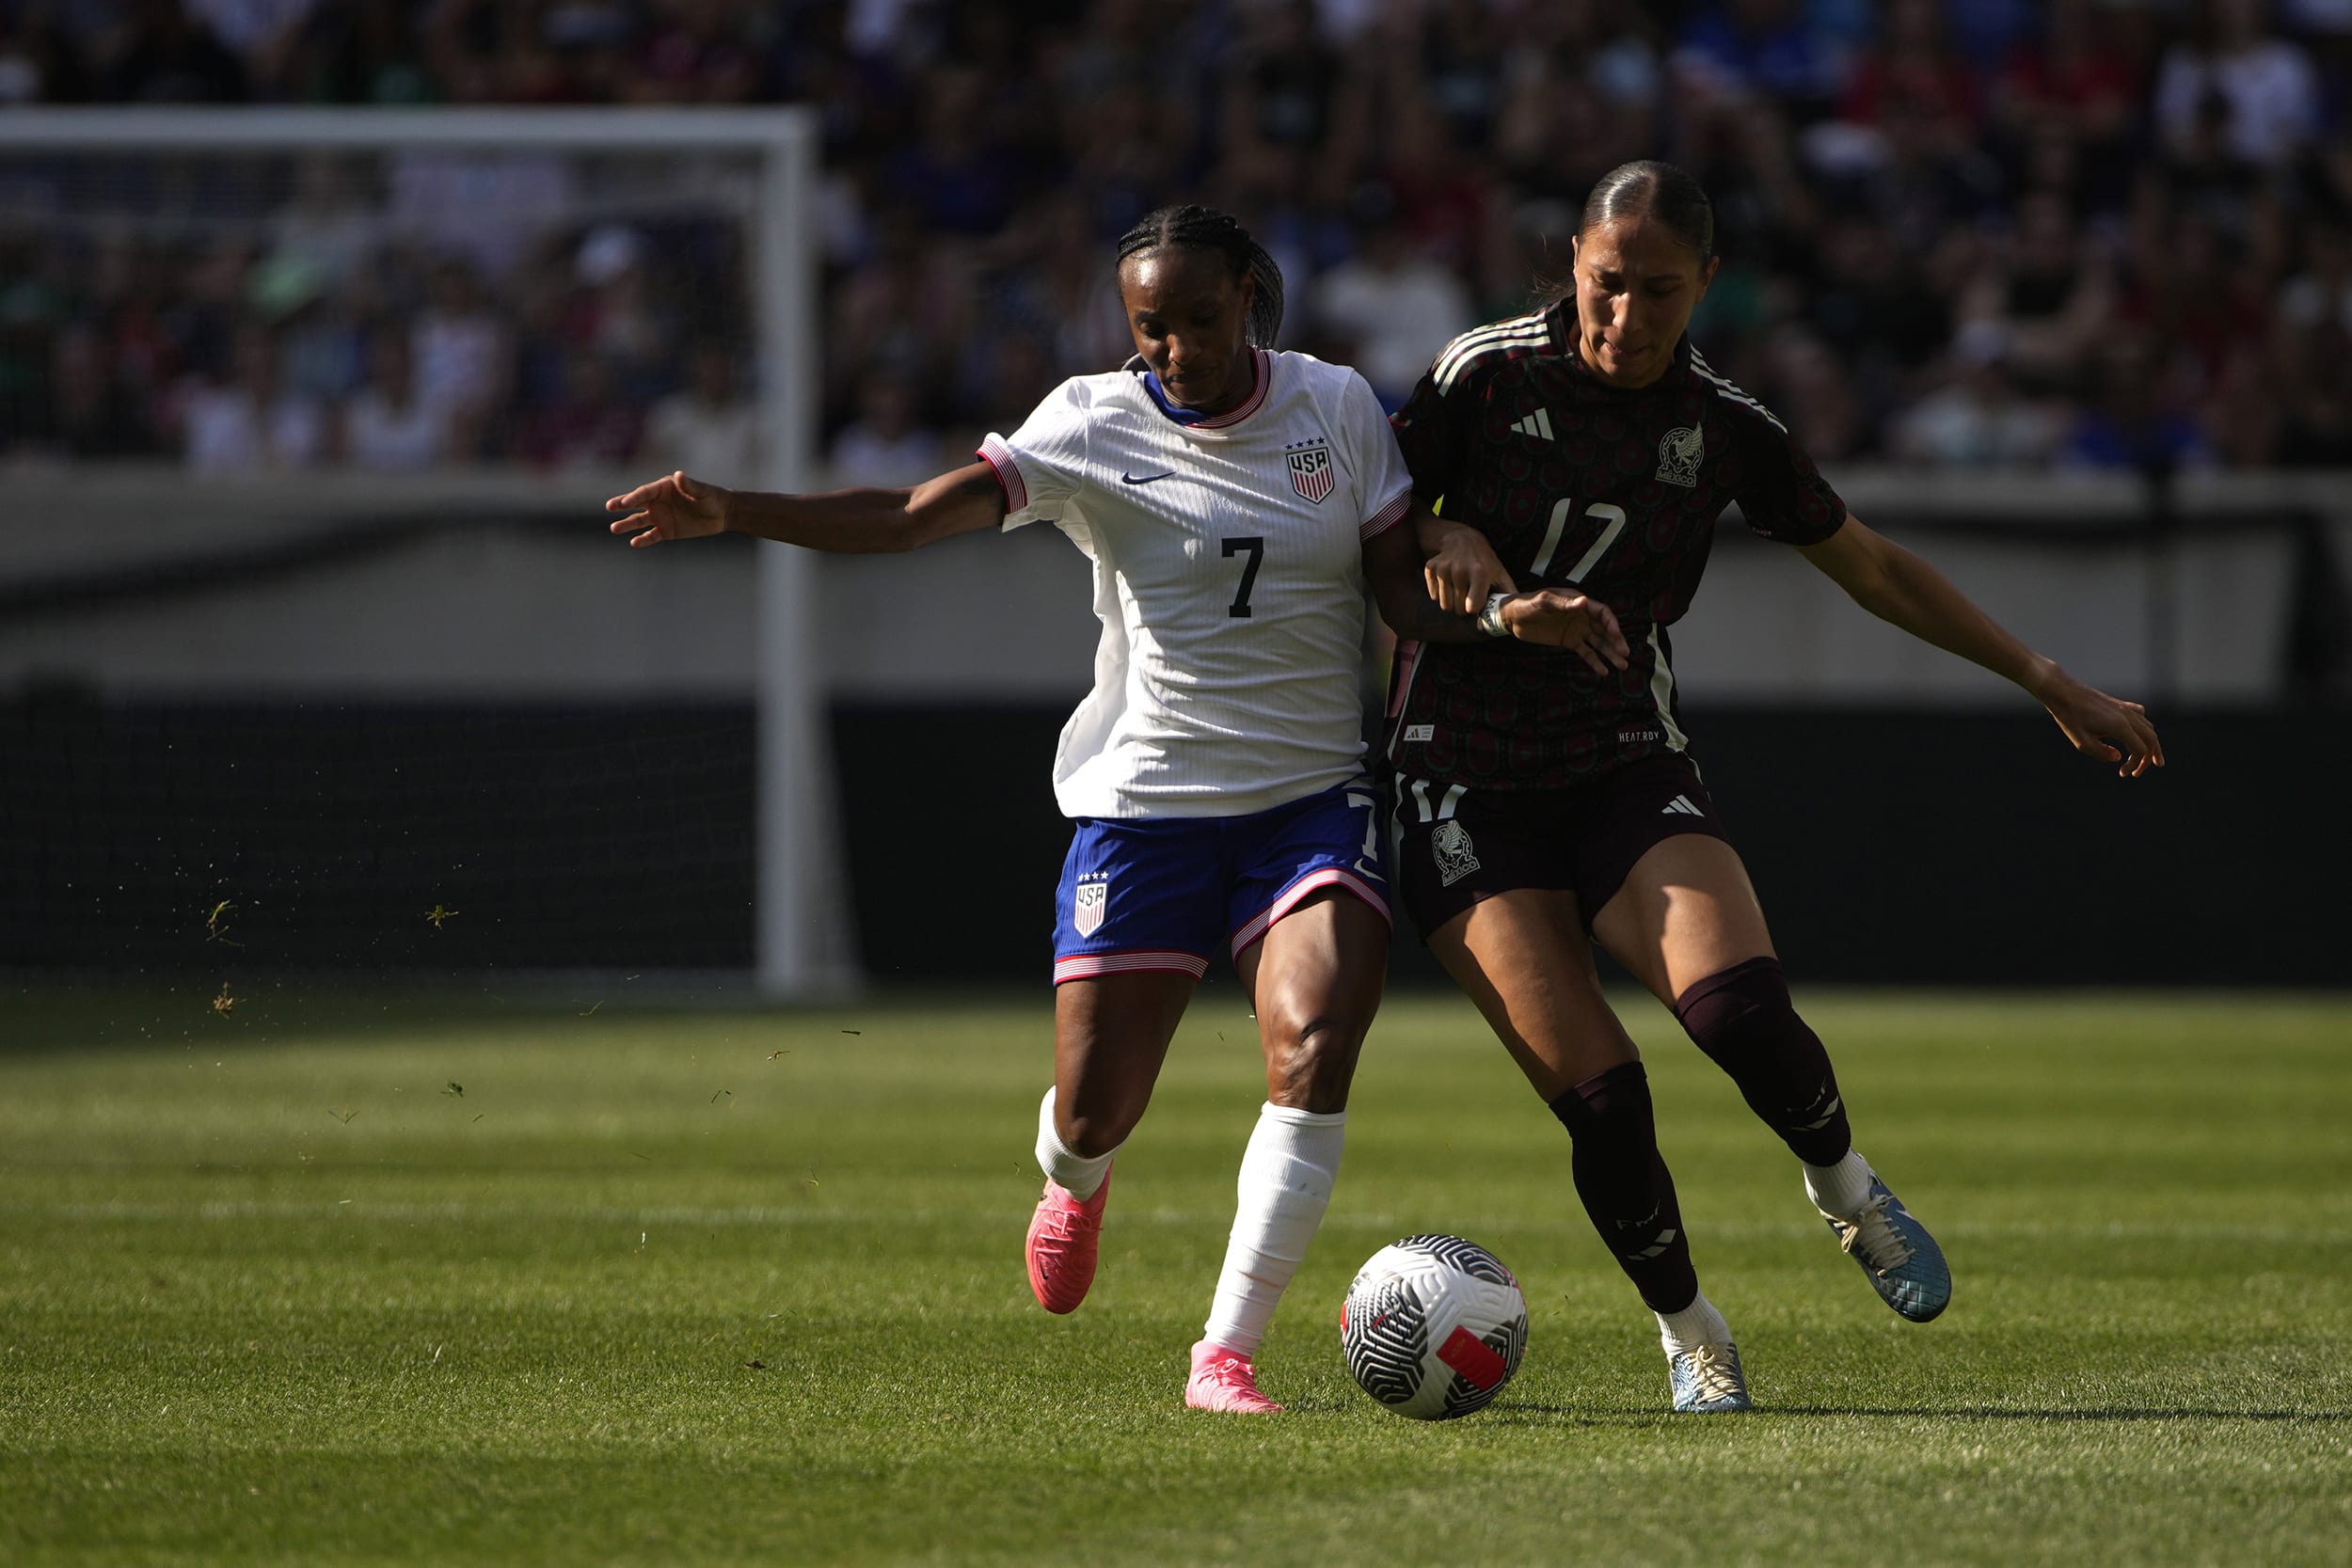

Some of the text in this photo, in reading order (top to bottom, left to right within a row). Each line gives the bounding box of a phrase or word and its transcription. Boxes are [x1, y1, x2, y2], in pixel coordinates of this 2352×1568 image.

[1290, 451, 1327, 473] USA
[1530, 498, 1626, 583] 17
[1221, 536, 1264, 617] 7
[1619, 731, 1659, 742] HEAT.RDY
[1346, 792, 1378, 863] 7
[1078, 886, 1104, 907] USA
